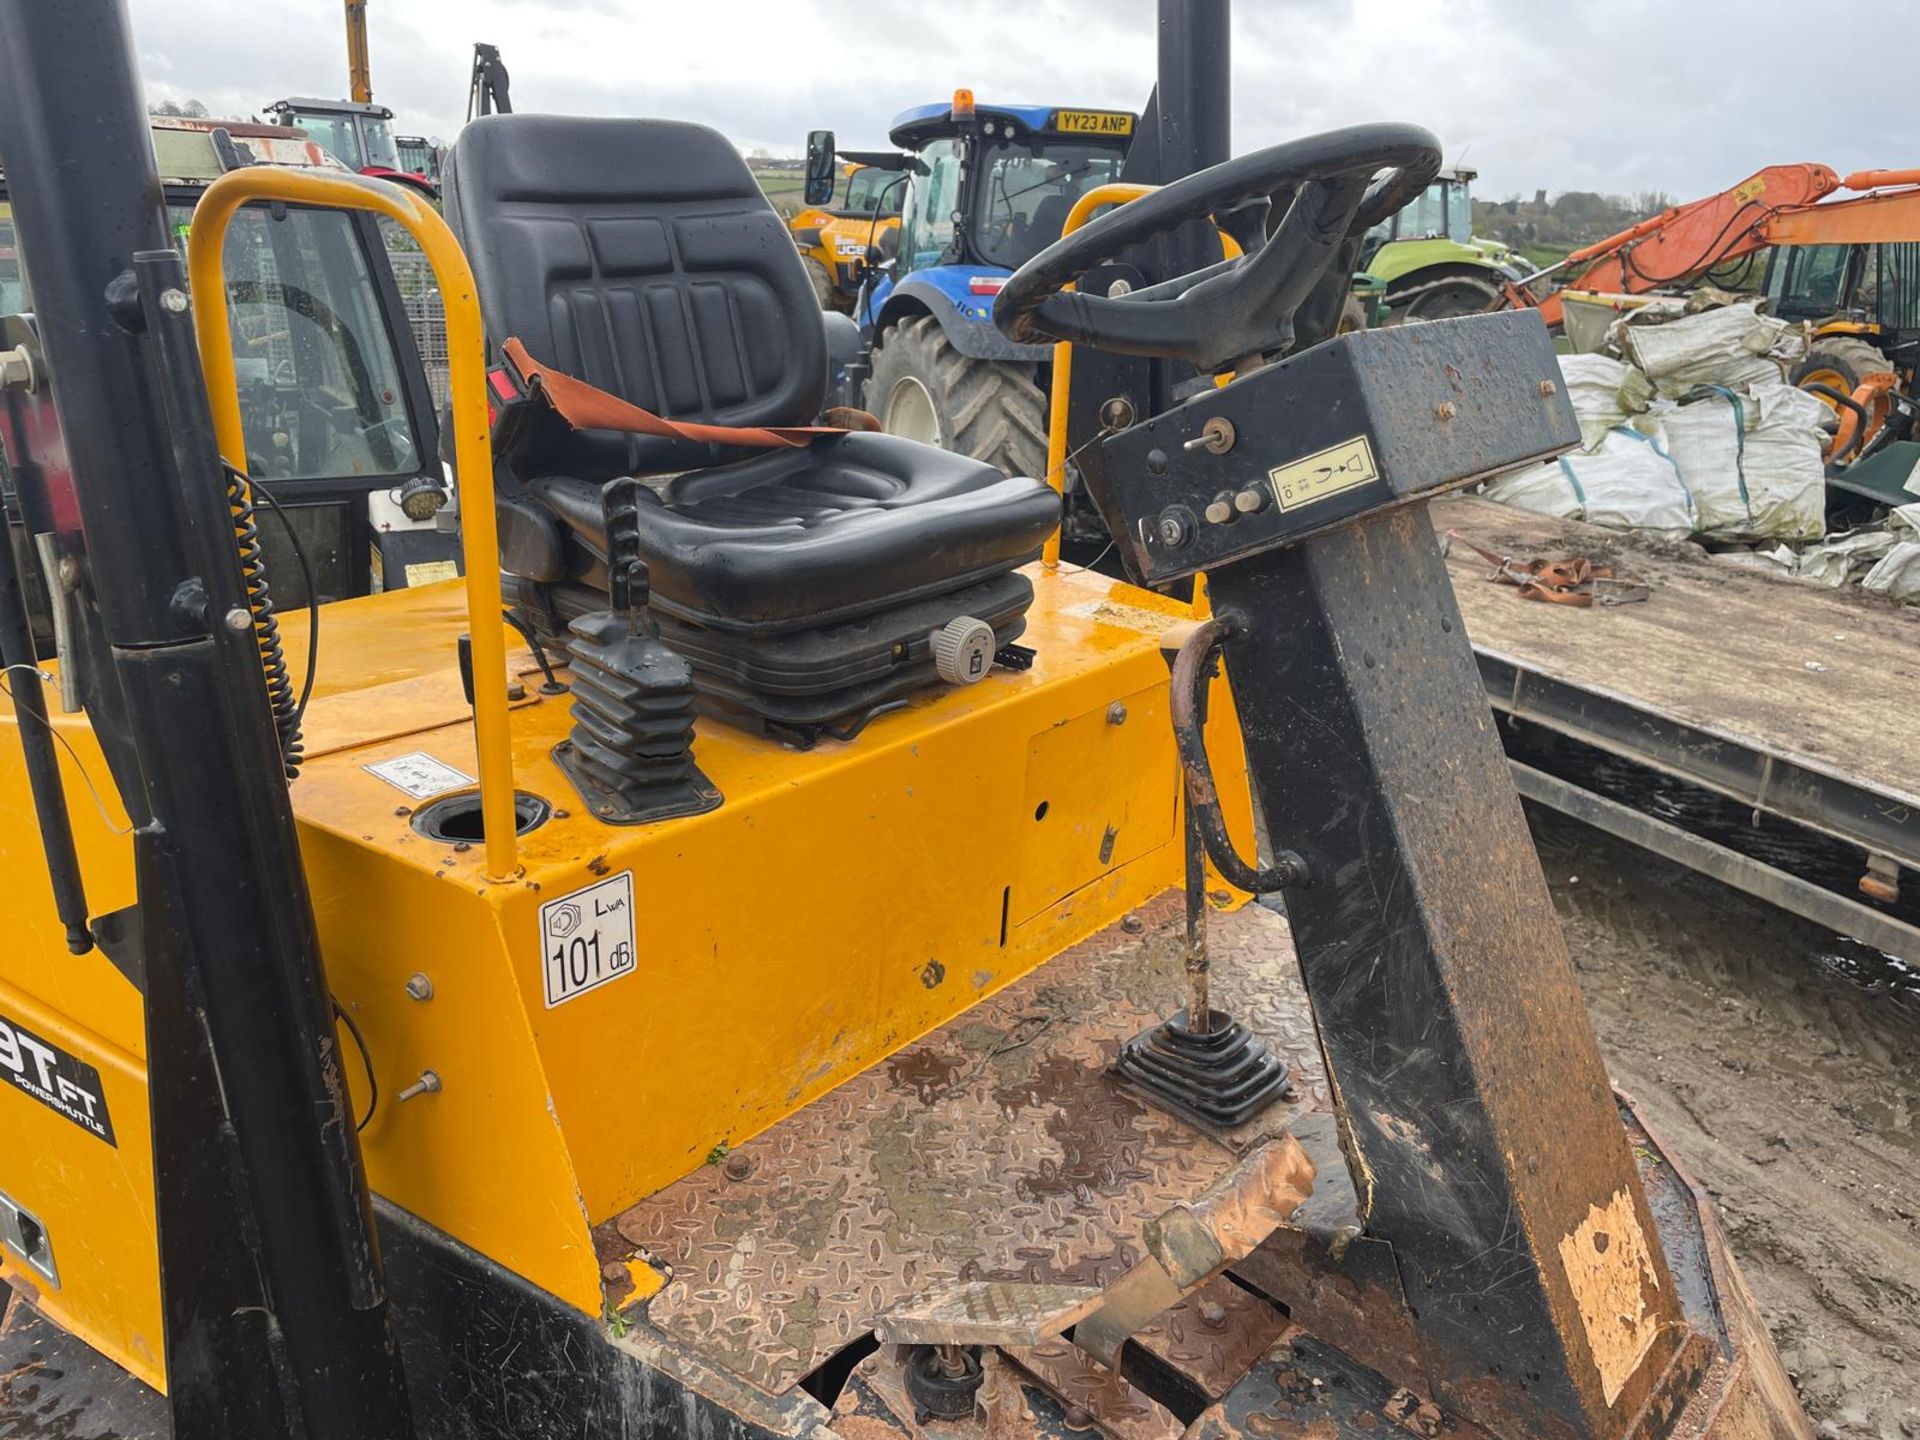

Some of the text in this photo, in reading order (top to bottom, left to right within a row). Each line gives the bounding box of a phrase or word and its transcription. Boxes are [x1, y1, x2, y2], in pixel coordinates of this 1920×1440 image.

[1064, 114, 1127, 132] YY23 ANP
[837, 245, 867, 255] JCB
[552, 929, 630, 993] 101 dB
[13, 1073, 106, 1136] POWERSHUTTLE
